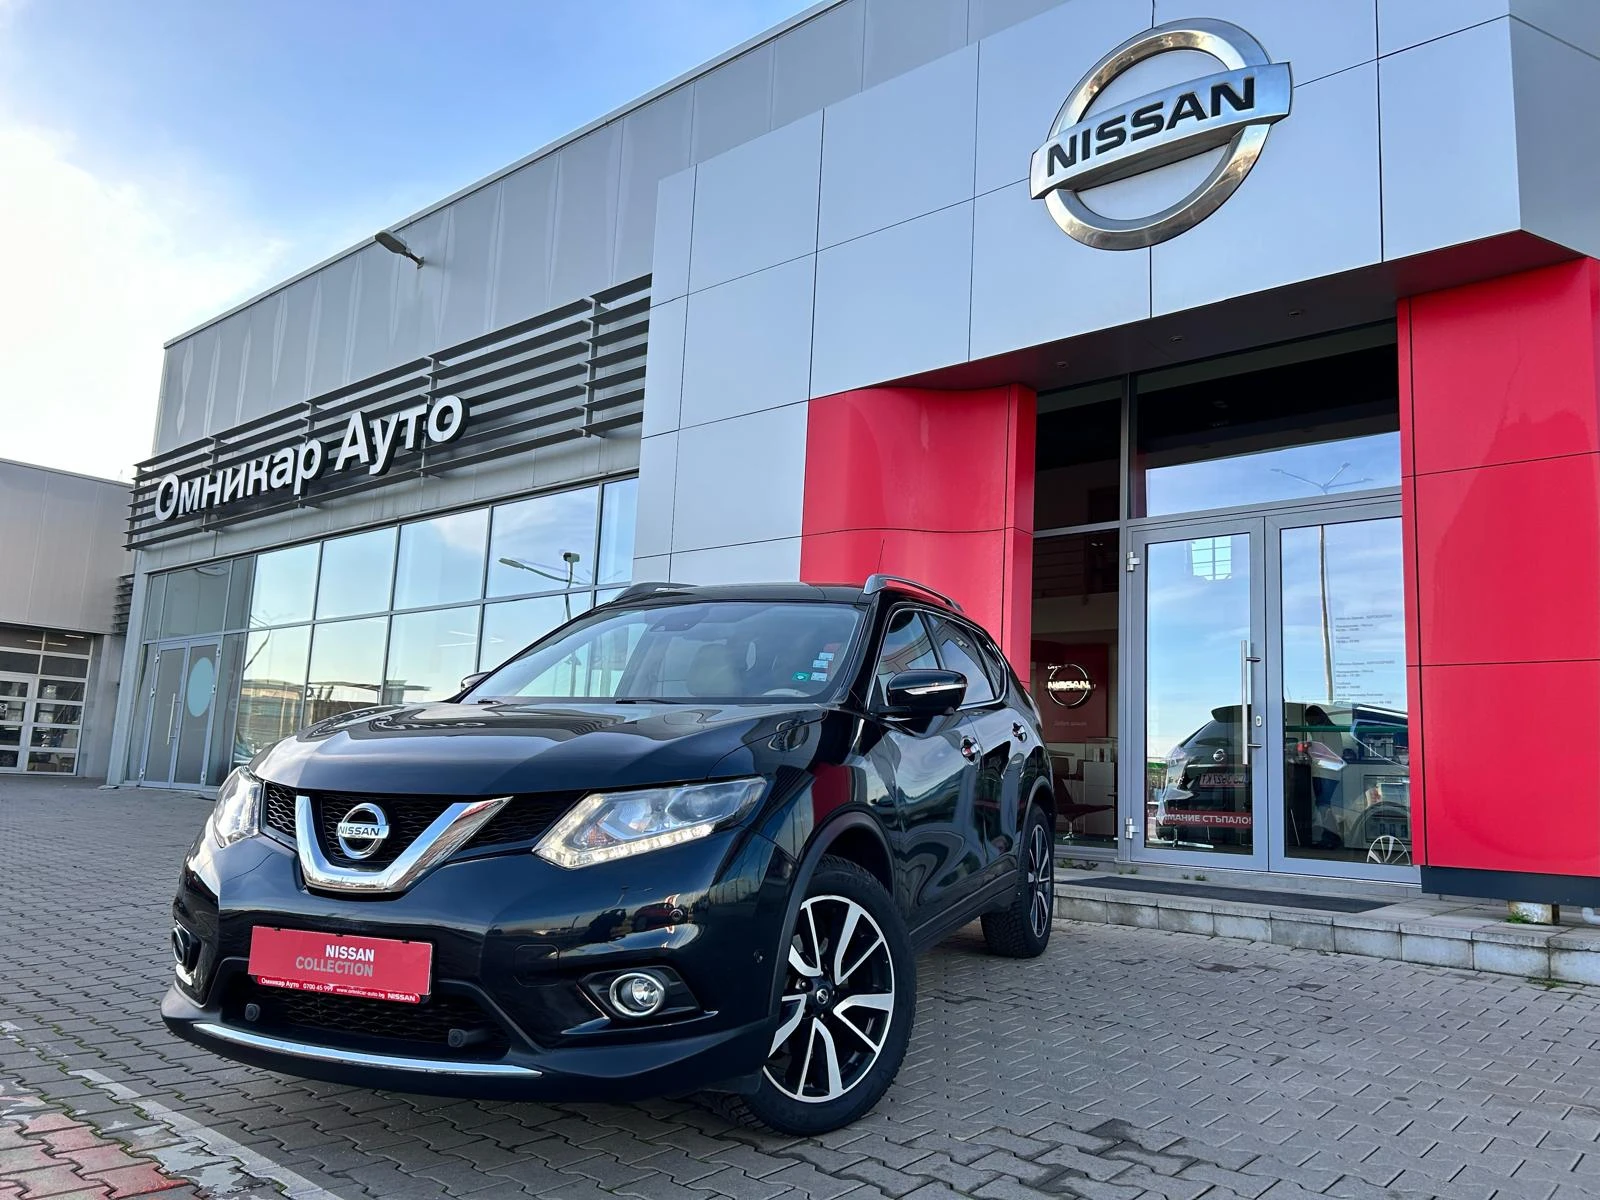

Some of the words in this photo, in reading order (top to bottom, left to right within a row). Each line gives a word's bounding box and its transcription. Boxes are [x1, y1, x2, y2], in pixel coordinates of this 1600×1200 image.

[1047, 76, 1255, 177] NISSAN
[154, 439, 324, 521] Омникар
[334, 395, 466, 476] Ауто
[339, 825, 381, 836] NISSAN
[1202, 815, 1251, 825] СТЪПАЛО!
[325, 944, 375, 962] NISSAN
[295, 956, 374, 977] COLLECTION
[286, 980, 300, 989] Ауто
[303, 982, 316, 991] 0700
[387, 992, 416, 1002] NISSAN
